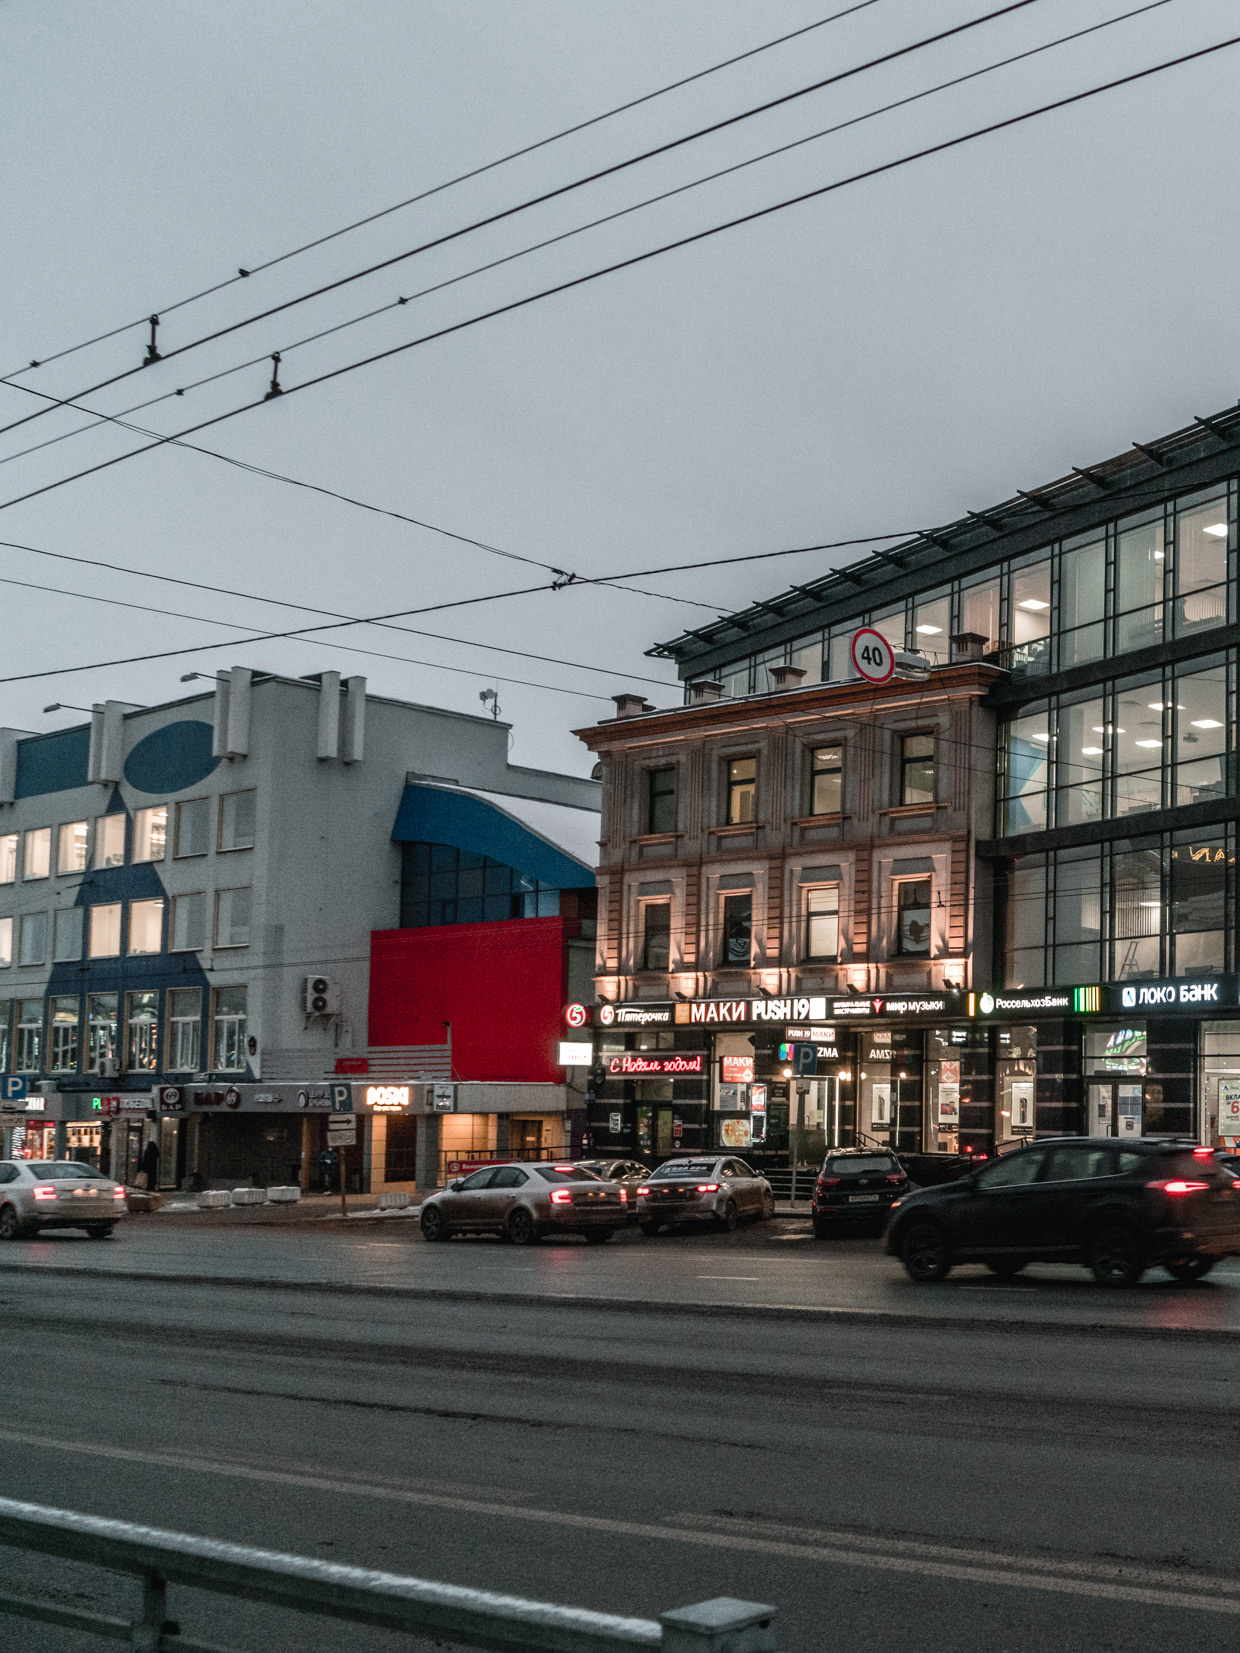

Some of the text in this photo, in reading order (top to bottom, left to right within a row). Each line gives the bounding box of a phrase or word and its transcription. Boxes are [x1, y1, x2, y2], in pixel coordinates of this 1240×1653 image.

[861, 645, 883, 667] 40
[995, 995, 1070, 1009] РоссельхозБанк
[1138, 986, 1176, 1005] ЛОКО
[691, 1001, 747, 1023] МАКИ
[751, 998, 810, 1021] PUSH 19
[787, 1029, 803, 1037] PUSH
[812, 1031, 834, 1039] МАКИ
[723, 1056, 754, 1067] МАКИ
[817, 1047, 839, 1058] ZMA
[7, 1077, 23, 1098] P
[366, 1086, 409, 1106] DOSKI
[334, 1087, 348, 1111] P
